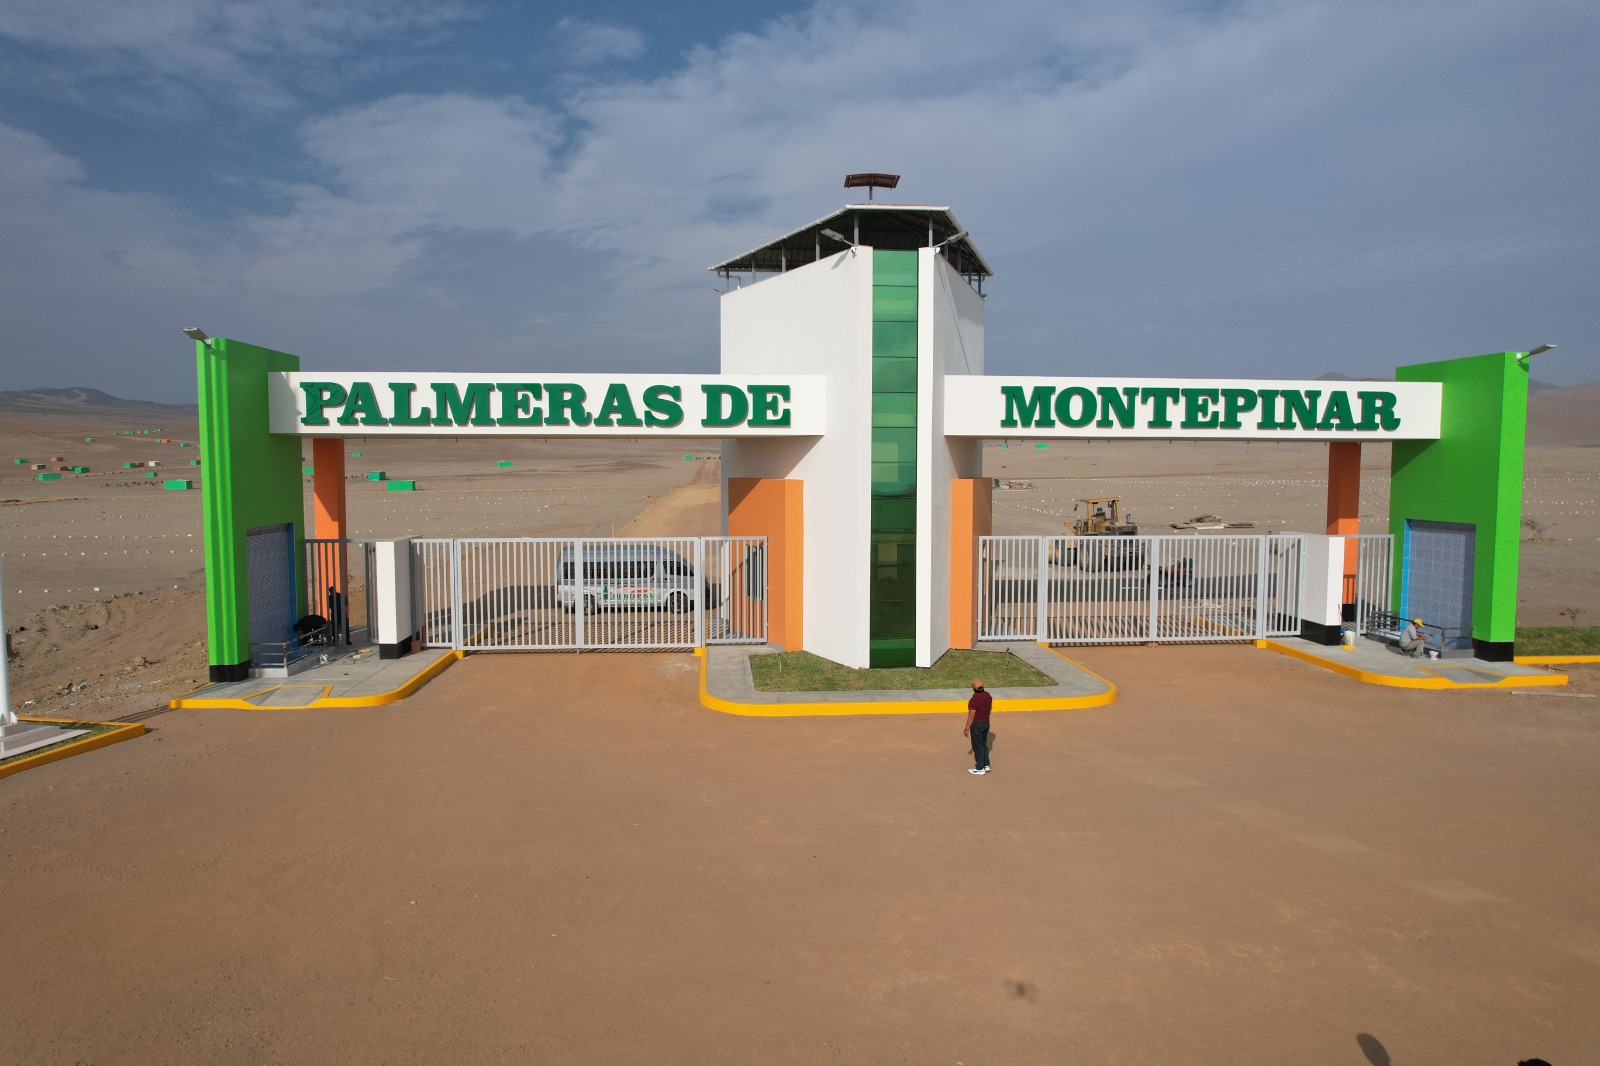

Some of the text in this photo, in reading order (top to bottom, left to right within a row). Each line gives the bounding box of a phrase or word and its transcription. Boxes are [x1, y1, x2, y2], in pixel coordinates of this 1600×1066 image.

[300, 381, 791, 428] PALMERAS DE
[1001, 386, 1401, 431] MONTEPINAR
